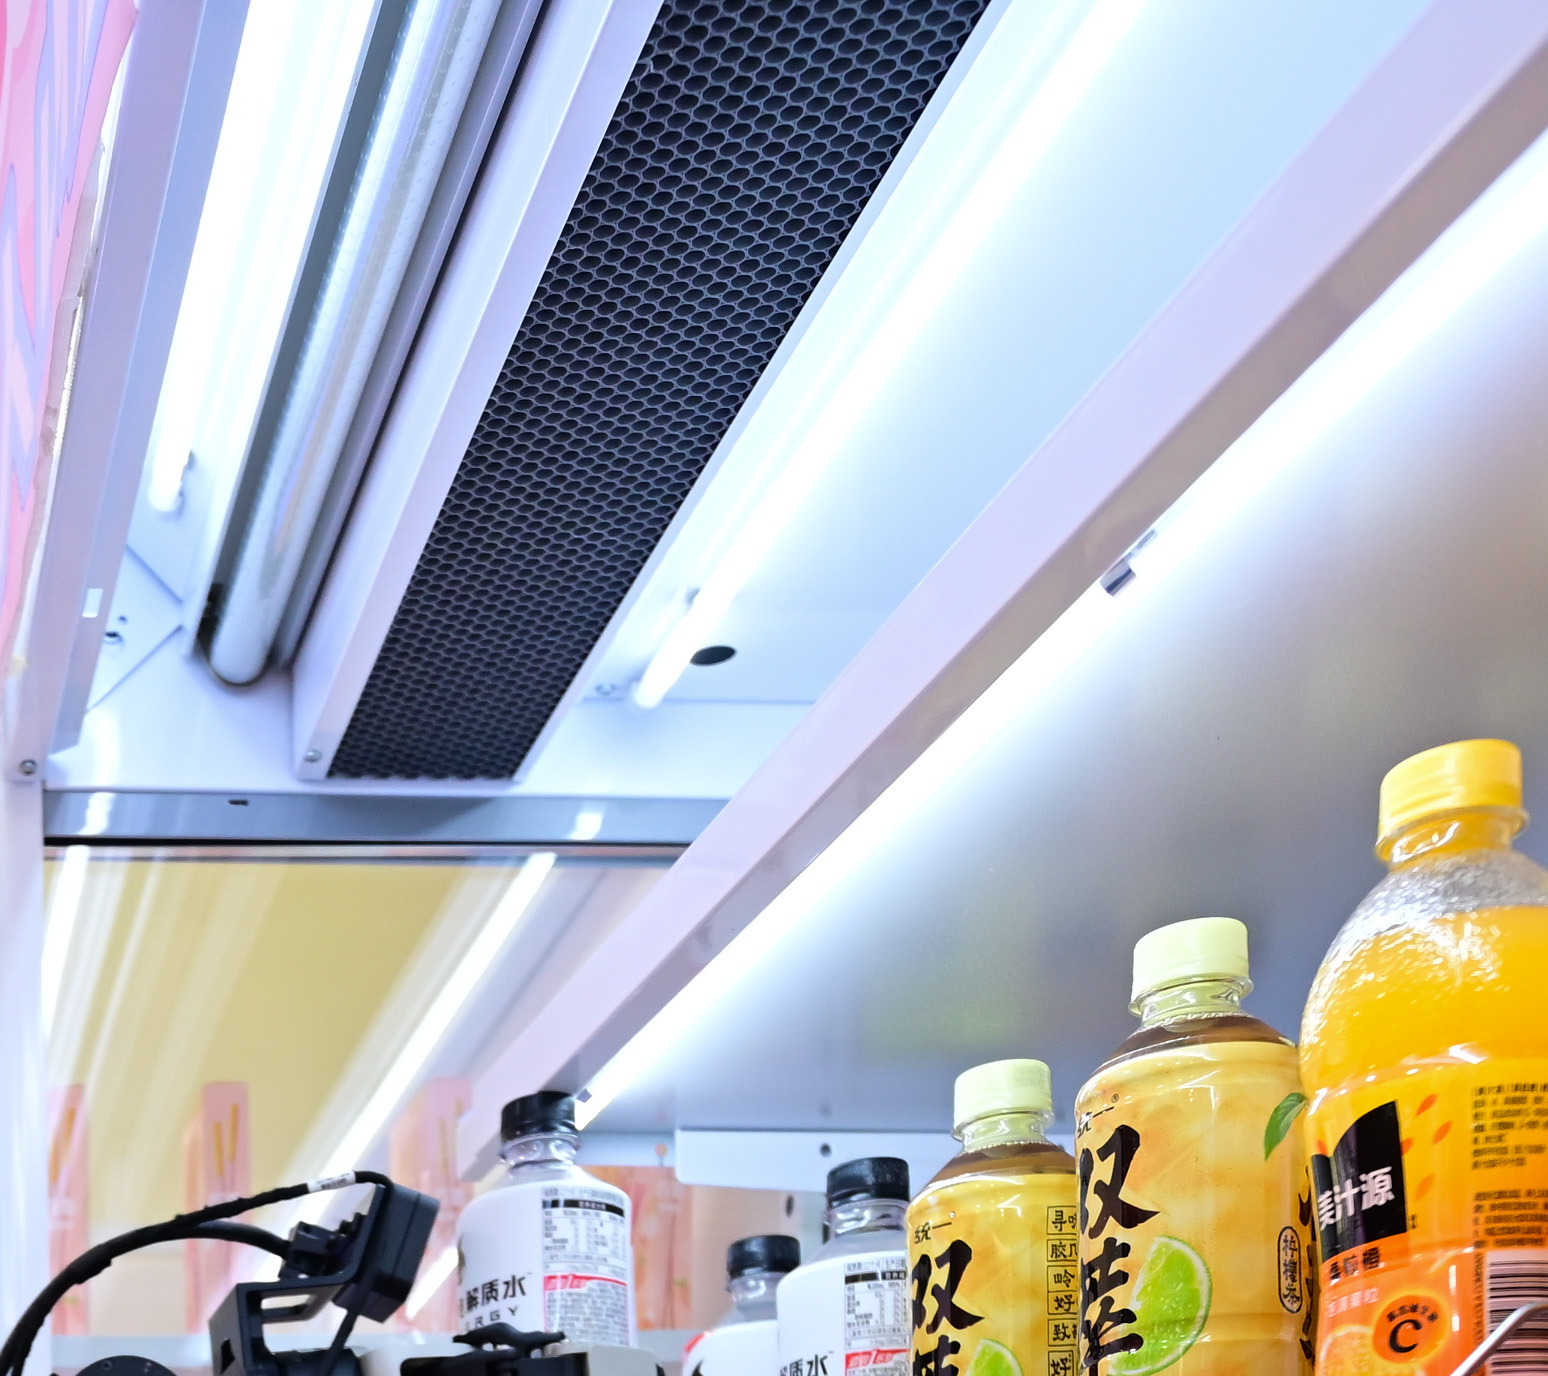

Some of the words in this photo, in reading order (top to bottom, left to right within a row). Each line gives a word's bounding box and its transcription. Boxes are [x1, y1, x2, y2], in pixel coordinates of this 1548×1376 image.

[1318, 1165, 1395, 1231] 美汁源
[914, 1221, 952, 1244] 统一
[459, 1274, 526, 1318] 解质水
[1389, 1318, 1424, 1354] C
